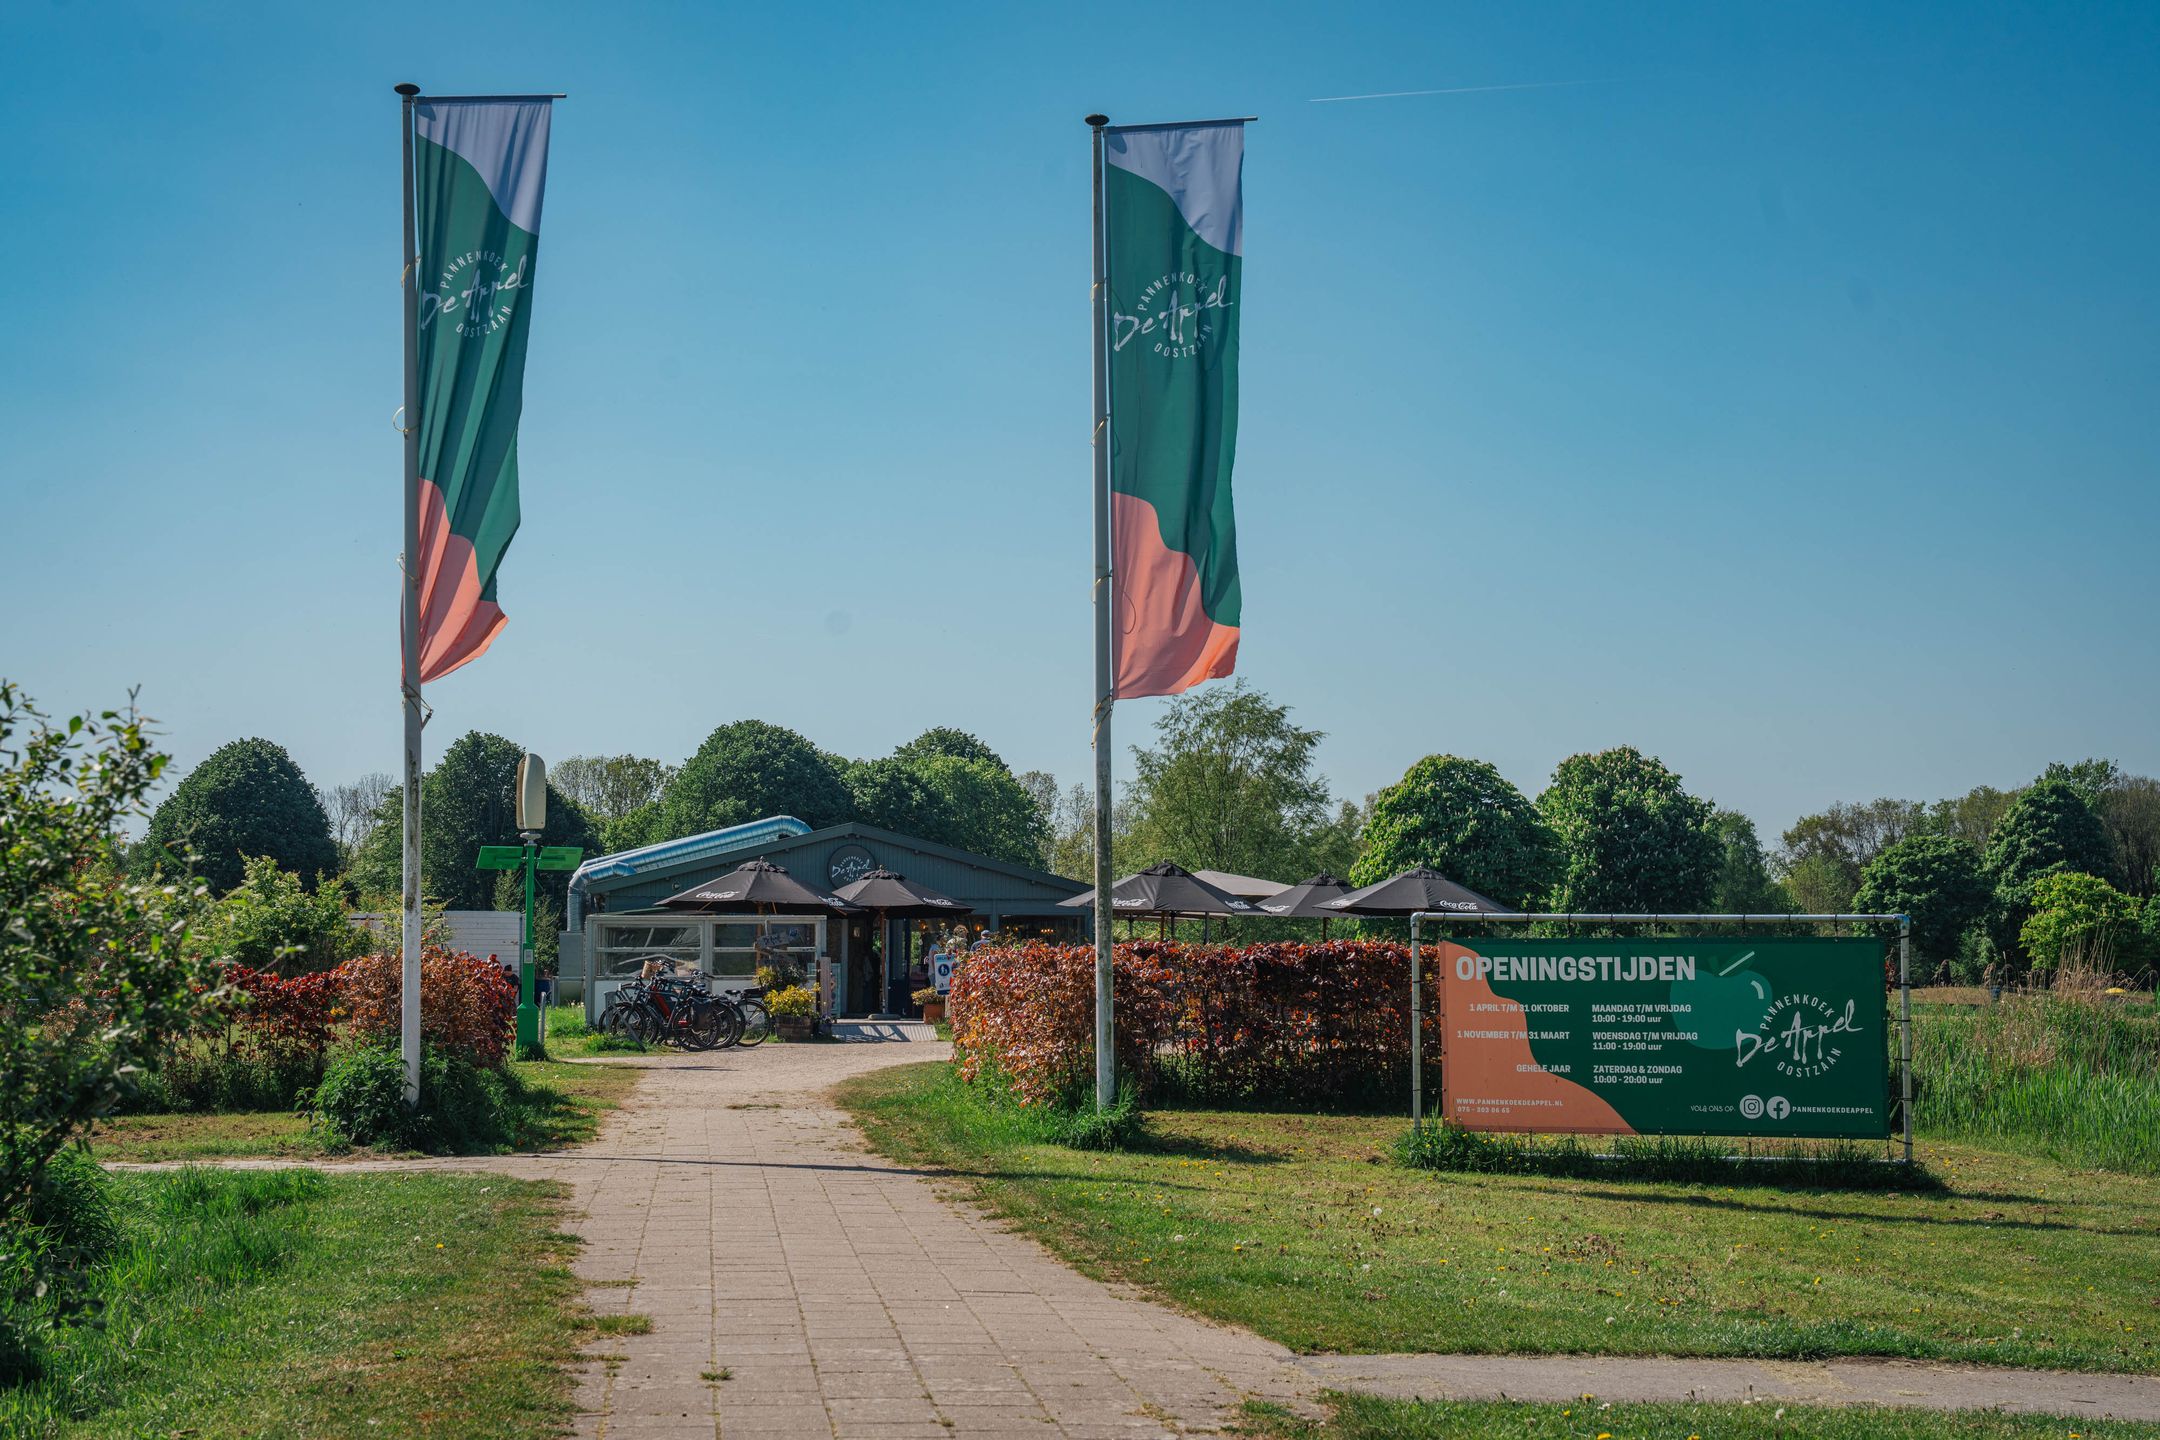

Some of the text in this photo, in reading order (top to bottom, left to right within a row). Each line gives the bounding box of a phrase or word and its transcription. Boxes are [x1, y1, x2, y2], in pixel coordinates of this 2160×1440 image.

[440, 250, 508, 289] PANNENKOEK
[421, 254, 528, 330] De Appel
[1138, 271, 1208, 311] PANNENKOEK
[1114, 274, 1234, 352] De Appel
[456, 305, 512, 338] OOSTZAAN
[1154, 325, 1212, 358] OOSTZAAN
[1456, 956, 1695, 981] OPENINGSTIJDEN
[1469, 1004, 1570, 1013] 1 APRIL T/M 31 OKTOBER
[1592, 1004, 1692, 1013] MAANDAG T/M VRIJDAG
[1760, 994, 1835, 1031] PANNENKOEK
[1592, 1014, 1616, 1023] 10:00
[1622, 1014, 1646, 1023] 19:00
[1457, 1030, 1570, 1040] 1 NOVEMBER T/M 31 MAART
[1592, 1031, 1698, 1041] WOENSDAG T/M VRIJDAG
[1736, 998, 1864, 1067] De Appel
[1593, 1042, 1616, 1050] 11:00
[1622, 1042, 1646, 1050] 19:00
[1777, 1048, 1842, 1078] OOSTZAAN
[1516, 1064, 1571, 1073] GEHELE JAAR
[1593, 1065, 1637, 1073] ZATERDAG
[1647, 1065, 1682, 1074] ZONDAG
[1593, 1075, 1617, 1083] 10:00
[1623, 1075, 1647, 1084] 20:00
[1456, 1098, 1563, 1107] WWW.PANNENKOEKDEAPPEL.NL
[1690, 1105, 1708, 1113] VOLG
[1792, 1106, 1874, 1114] PANNENKOEKDEAPPEL
